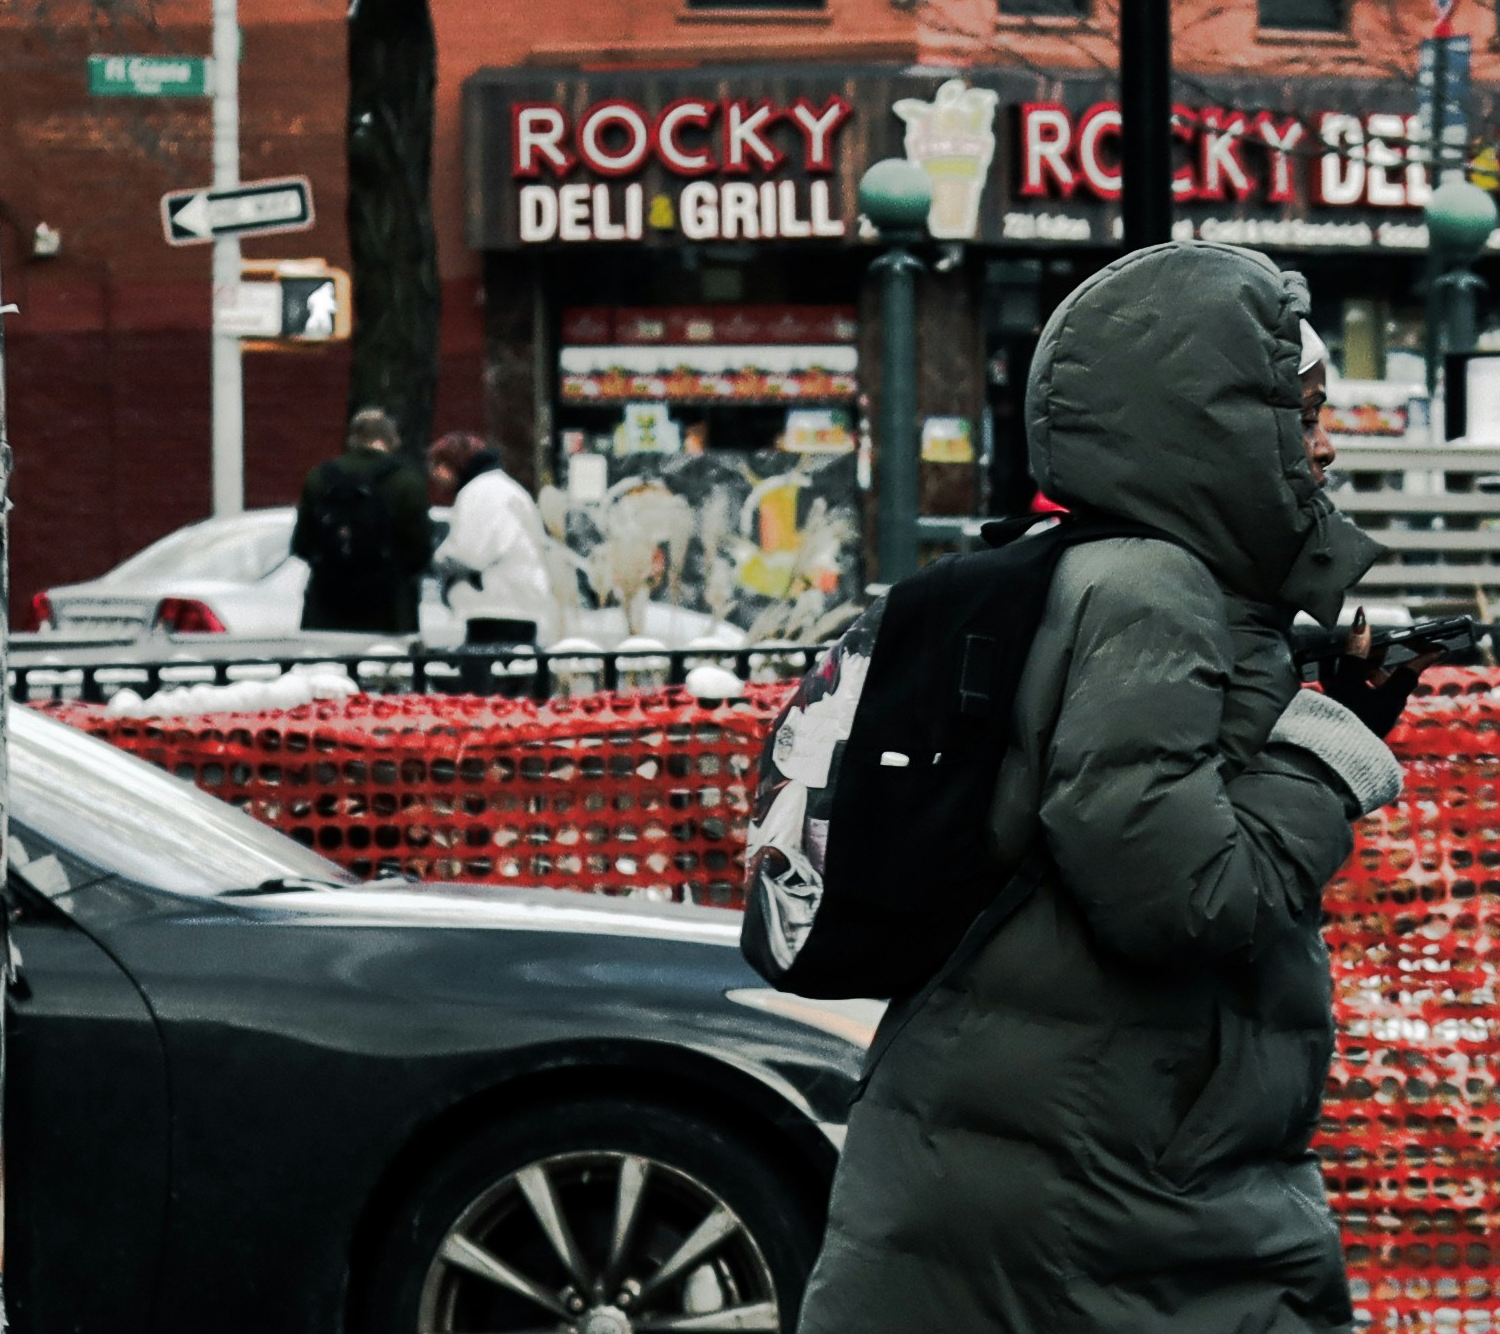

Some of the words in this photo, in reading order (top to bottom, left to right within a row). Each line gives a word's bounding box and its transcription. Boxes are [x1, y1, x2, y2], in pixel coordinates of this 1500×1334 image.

[512, 95, 850, 177] ROCKY
[519, 183, 642, 241] DELI
[681, 180, 845, 240] GRILL
